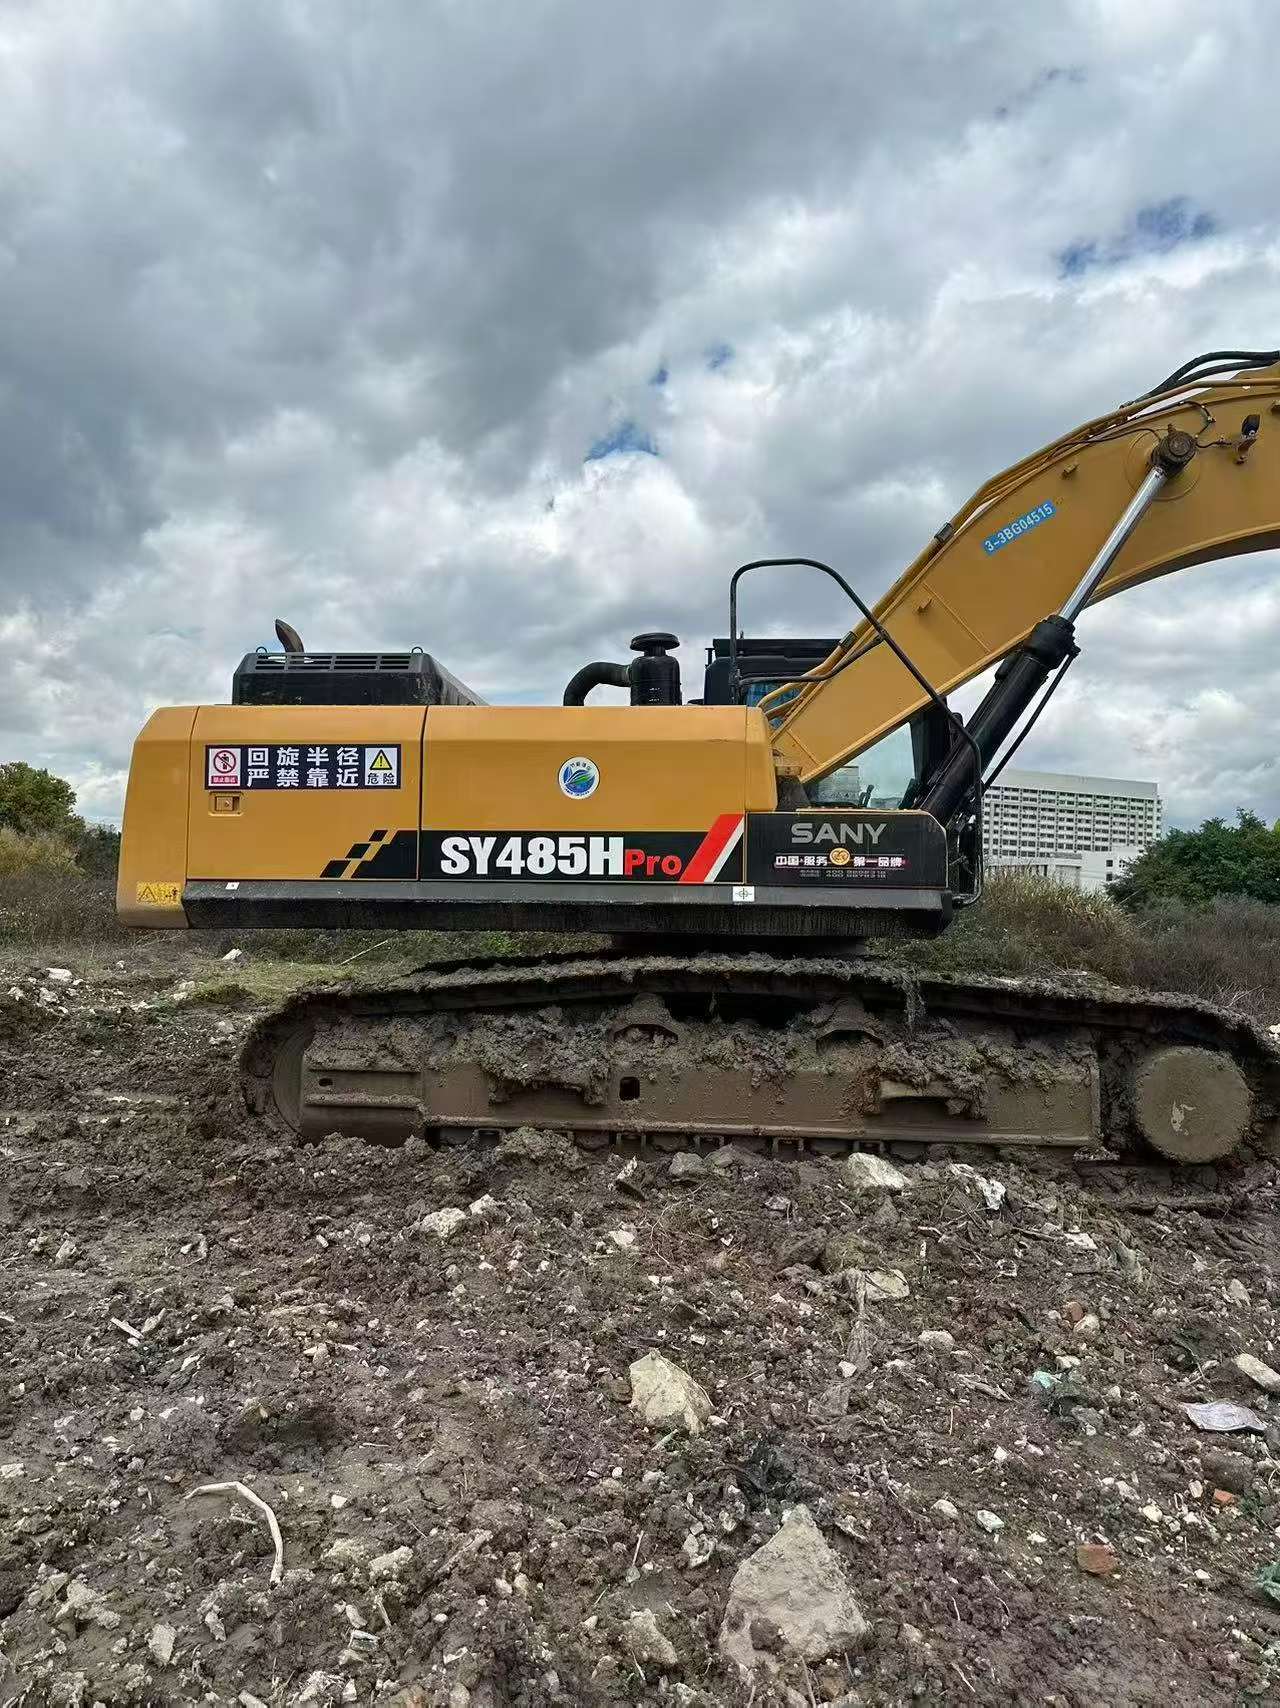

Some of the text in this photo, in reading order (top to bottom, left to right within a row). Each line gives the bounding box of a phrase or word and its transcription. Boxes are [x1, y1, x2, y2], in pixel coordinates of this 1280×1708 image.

[985, 503, 1053, 551] 3-3BG04515
[247, 747, 359, 766] 回旋半径
[247, 768, 359, 787] 严禁靠近
[367, 772, 395, 785] 危险
[791, 823, 887, 844] SANY
